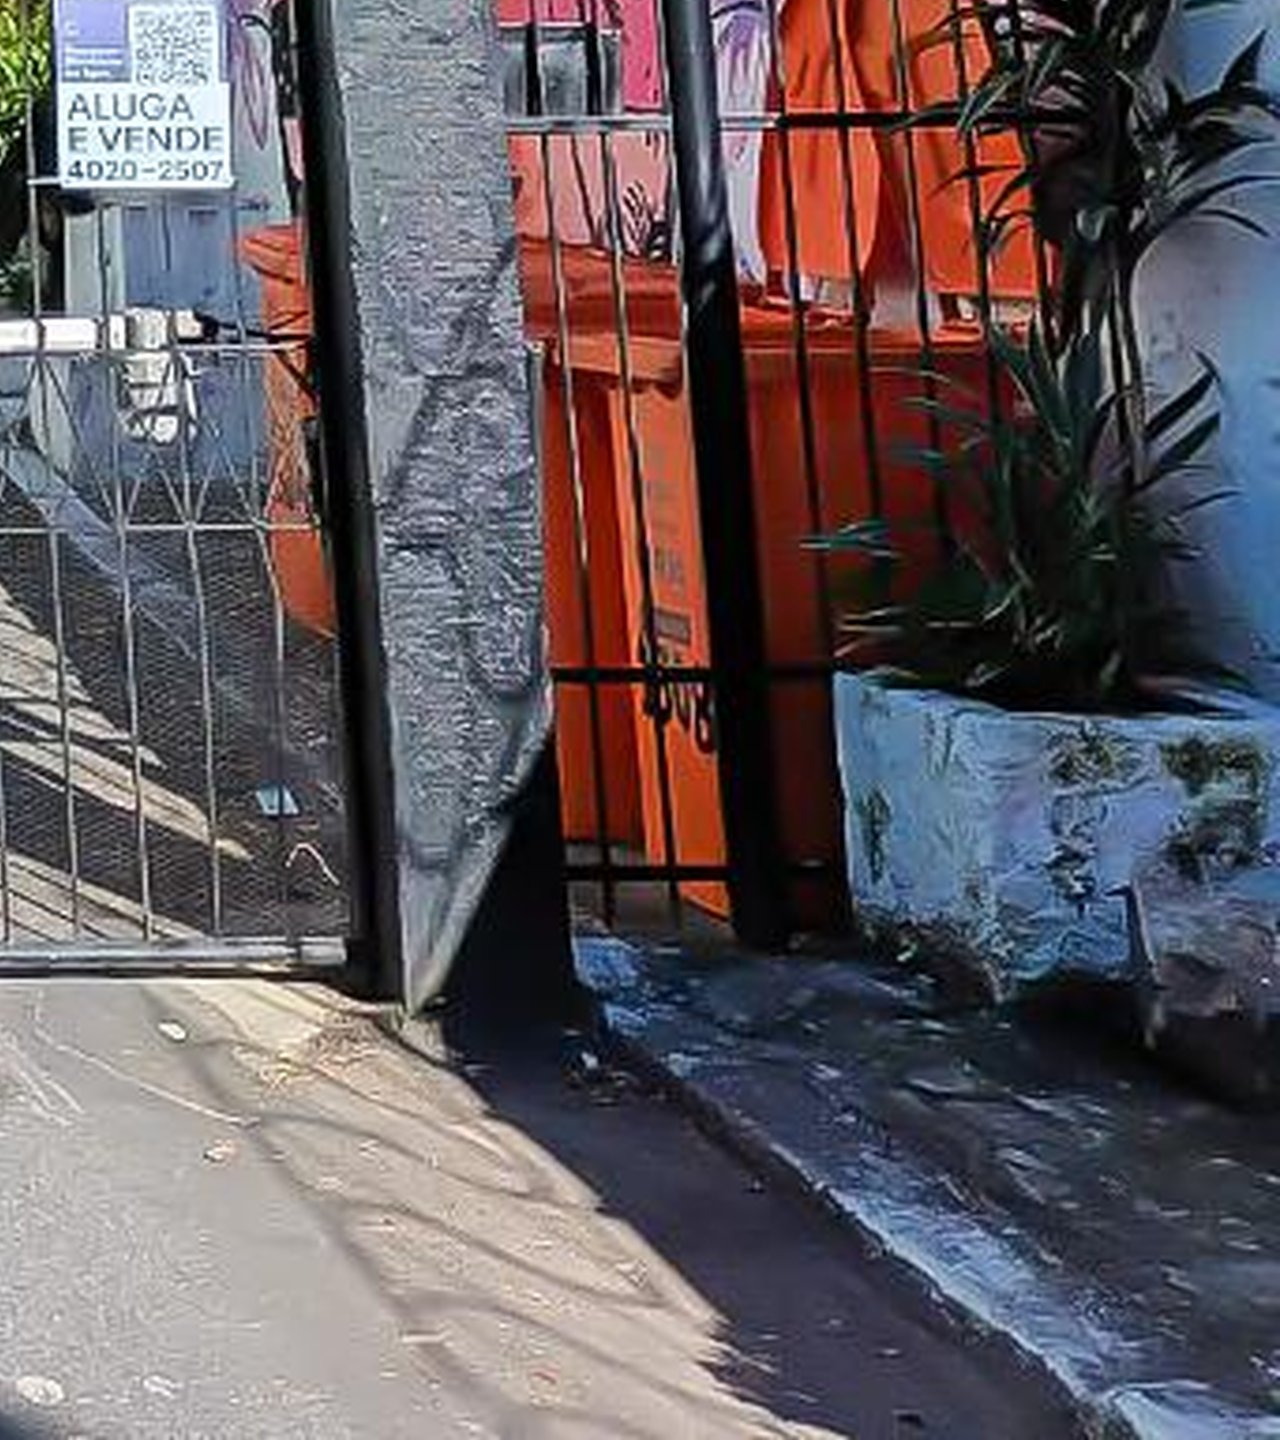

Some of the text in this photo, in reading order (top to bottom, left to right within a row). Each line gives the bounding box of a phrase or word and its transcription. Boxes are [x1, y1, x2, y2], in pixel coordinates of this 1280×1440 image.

[67, 93, 194, 121] ALUGA
[67, 126, 224, 153] E VENDE
[67, 160, 224, 181] 4020-2507
